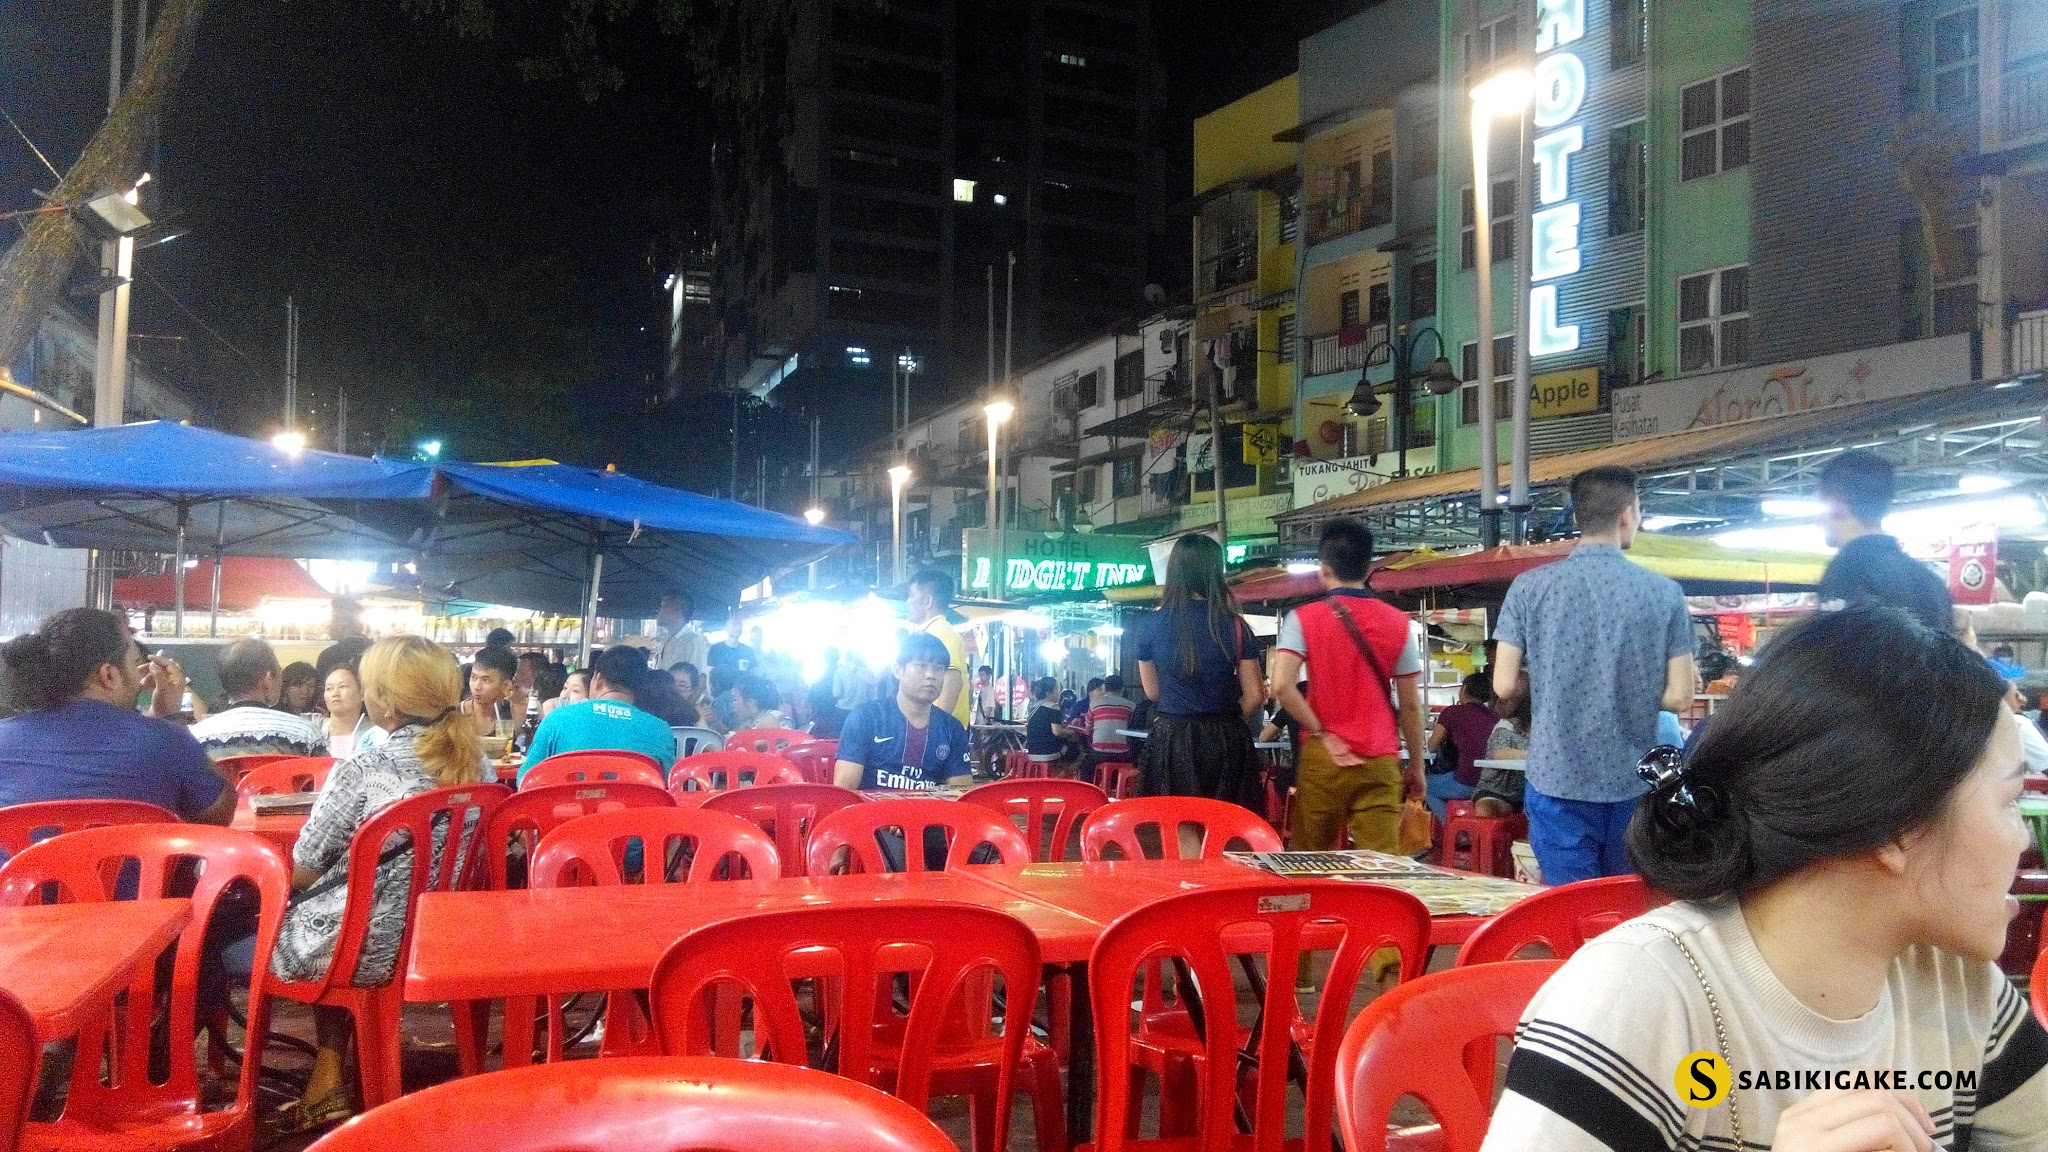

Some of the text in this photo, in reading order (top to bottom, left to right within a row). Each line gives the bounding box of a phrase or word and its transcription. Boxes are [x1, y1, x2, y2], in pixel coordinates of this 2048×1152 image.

[1530, 0, 1586, 357] HOTEL
[1530, 379, 1590, 408] Apple
[1300, 458, 1370, 476] TUKANG JAHIT
[1182, 505, 1217, 518] PERCUTIA
[1024, 538, 1095, 559] HOTEL
[1096, 563, 1147, 588] INN
[876, 769, 938, 791] Emirate
[901, 765, 923, 779] Fly
